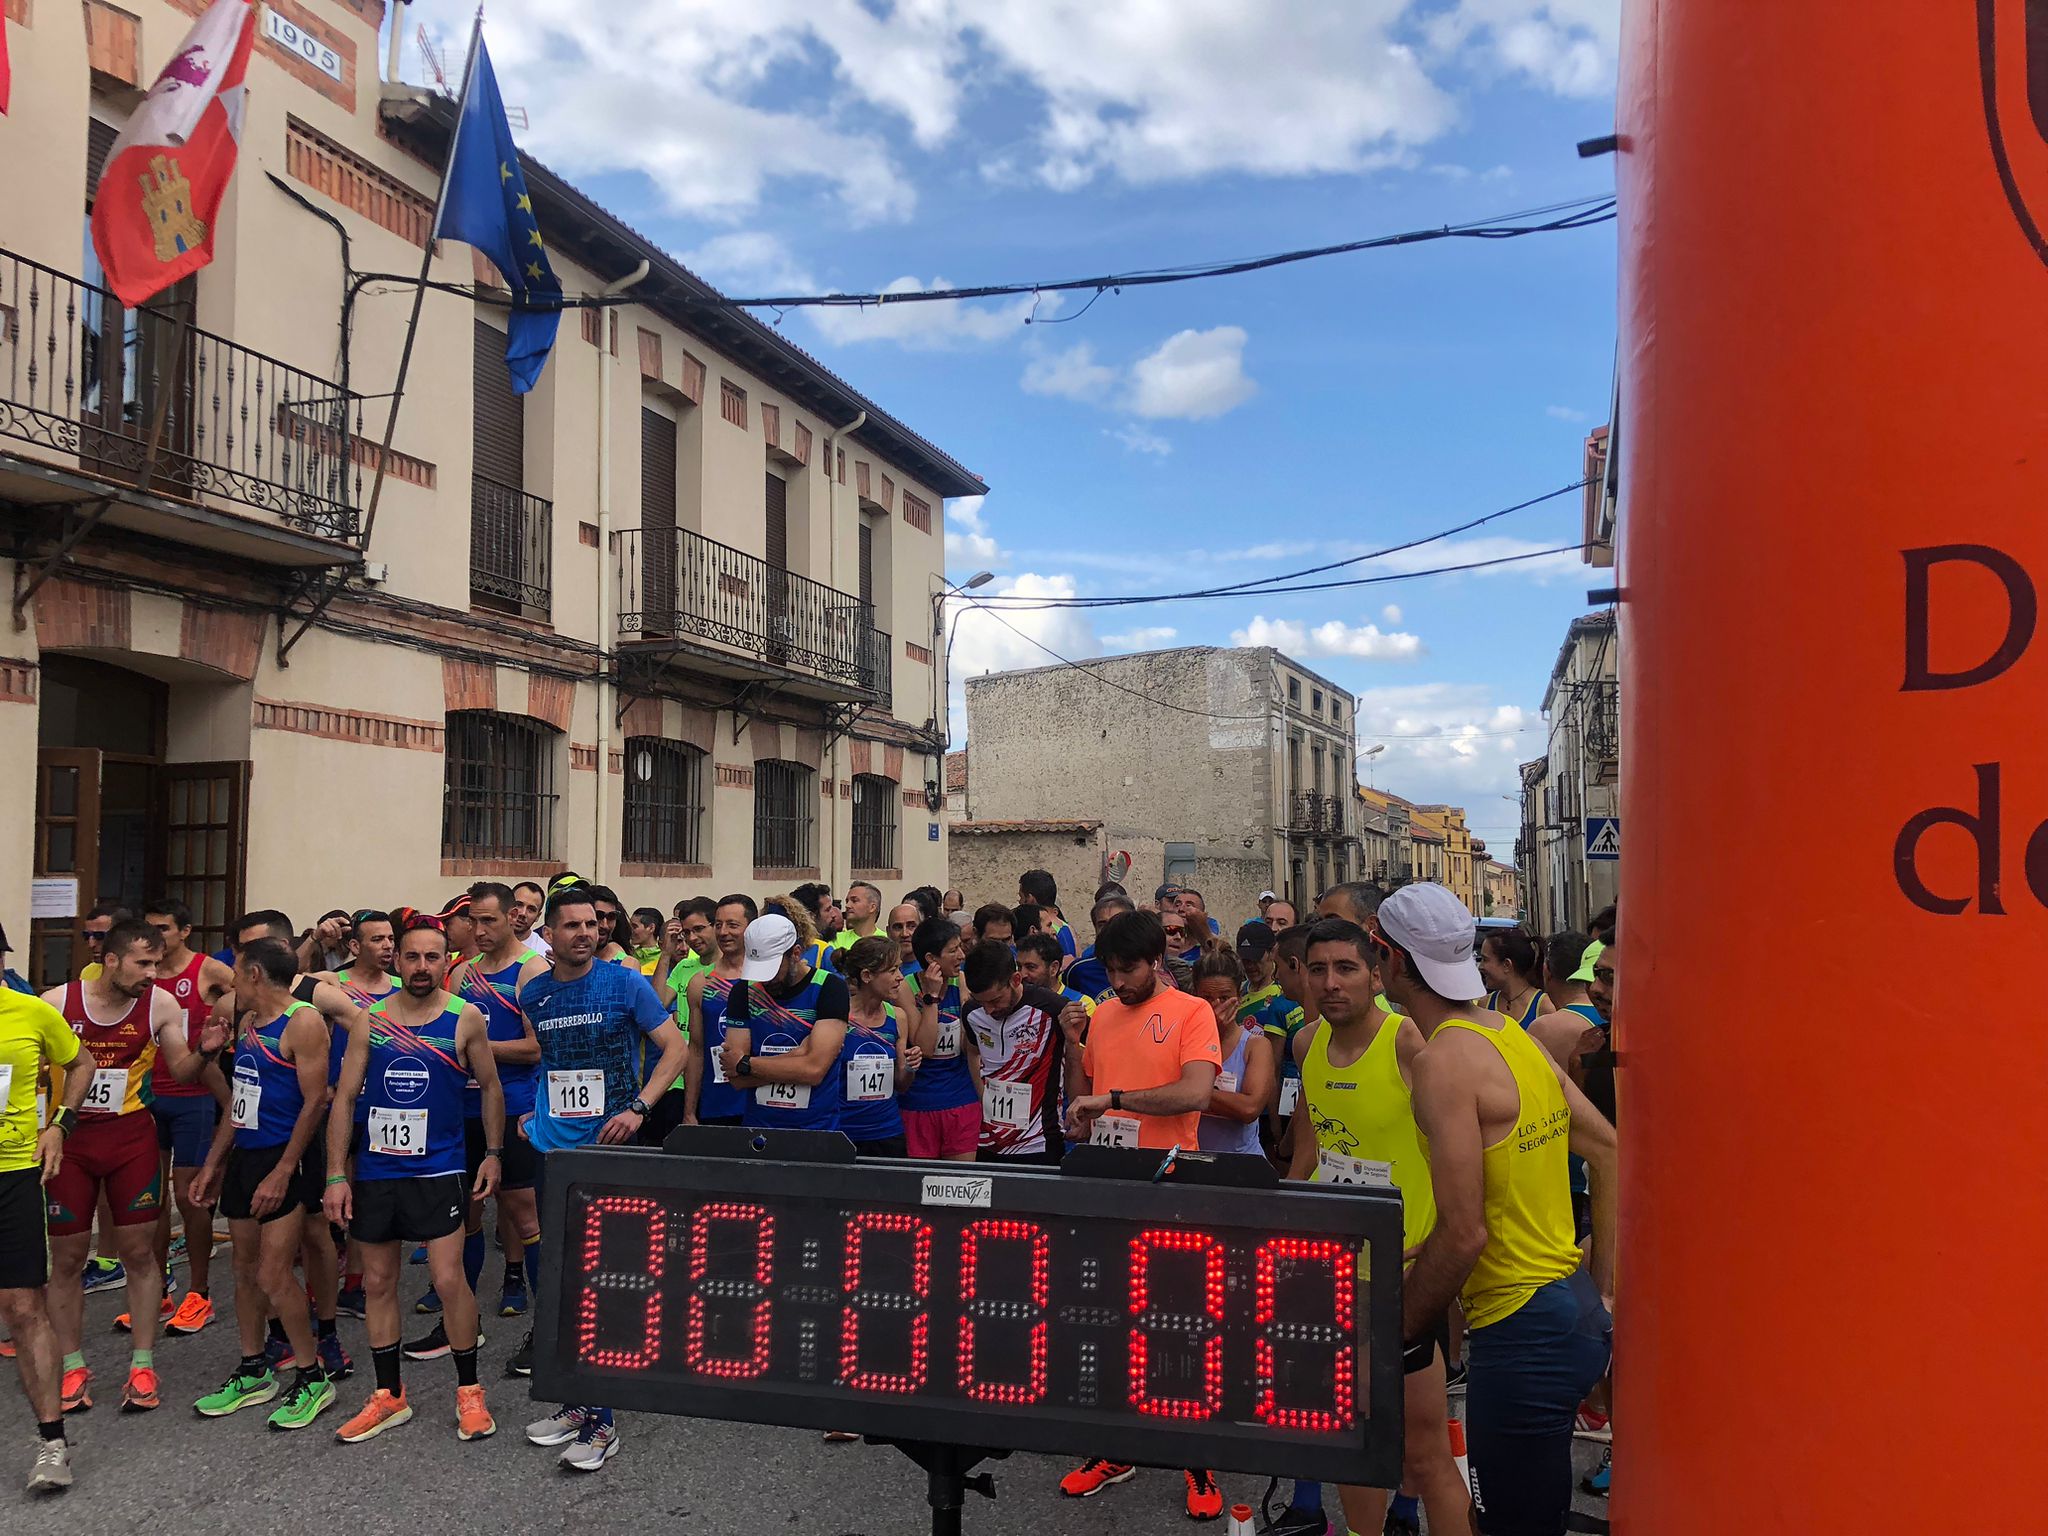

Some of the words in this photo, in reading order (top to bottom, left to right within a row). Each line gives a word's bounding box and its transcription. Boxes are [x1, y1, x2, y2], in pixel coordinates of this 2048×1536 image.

[273, 15, 335, 70] 1905
[538, 1012, 603, 1032] FUENTERREBOLLO
[769, 1082, 797, 1099] 143
[860, 1073, 885, 1093] 147
[561, 1085, 589, 1109] 118
[991, 1095, 1014, 1120] 111
[381, 1123, 411, 1147] 113
[1517, 1121, 1538, 1138] LOS
